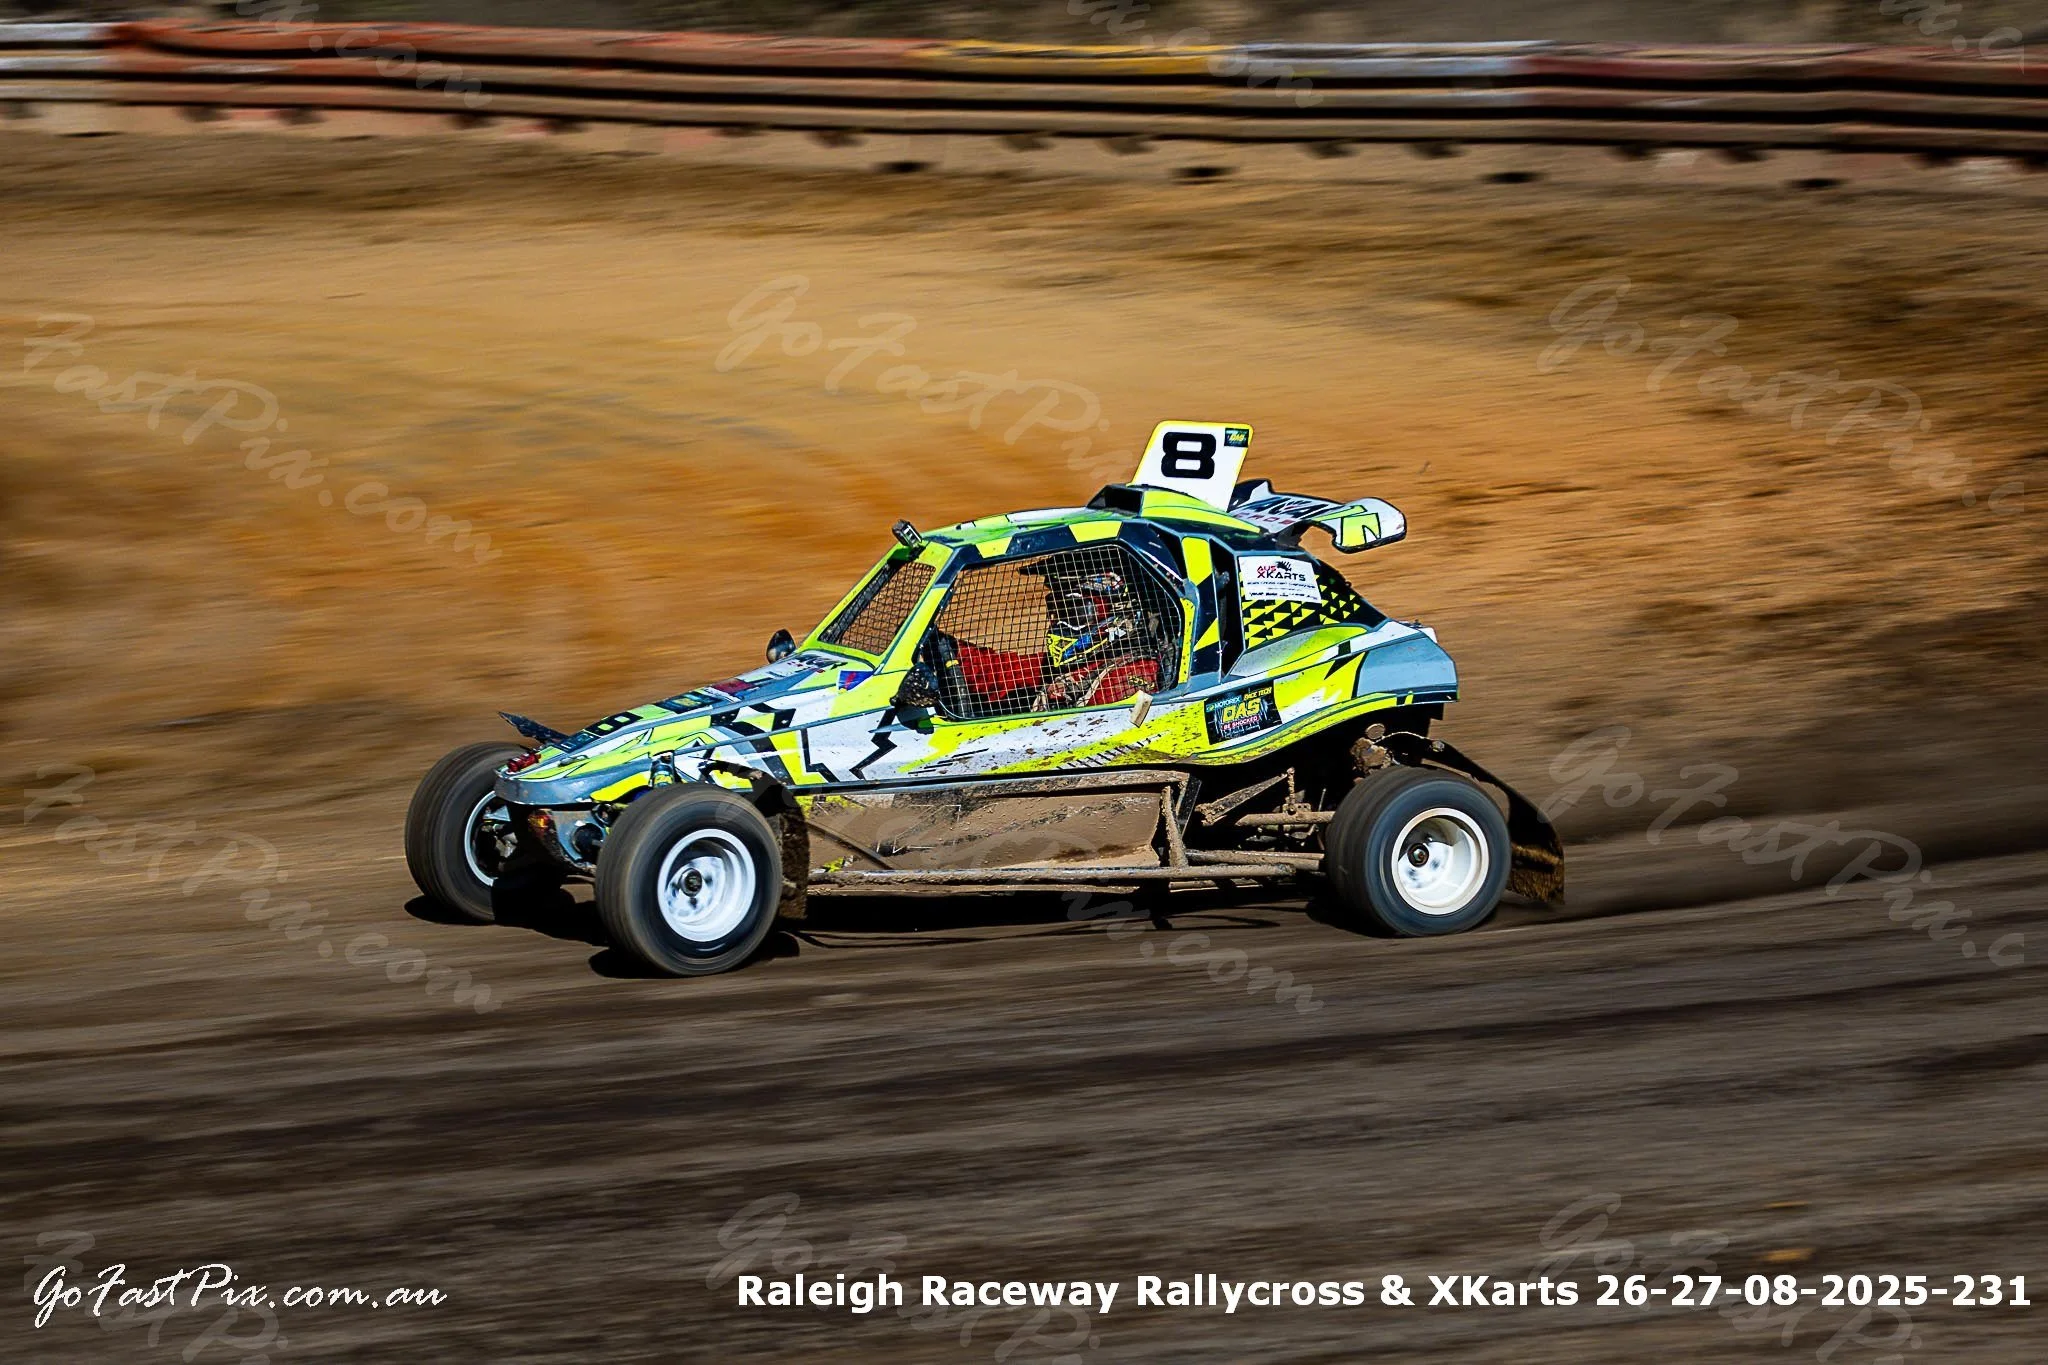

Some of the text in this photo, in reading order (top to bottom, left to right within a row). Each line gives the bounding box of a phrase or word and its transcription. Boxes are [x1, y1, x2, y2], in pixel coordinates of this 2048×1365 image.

[1161, 432, 1216, 479] 8
[1257, 570, 1306, 581] XKARTS
[1223, 698, 1261, 723] DAS
